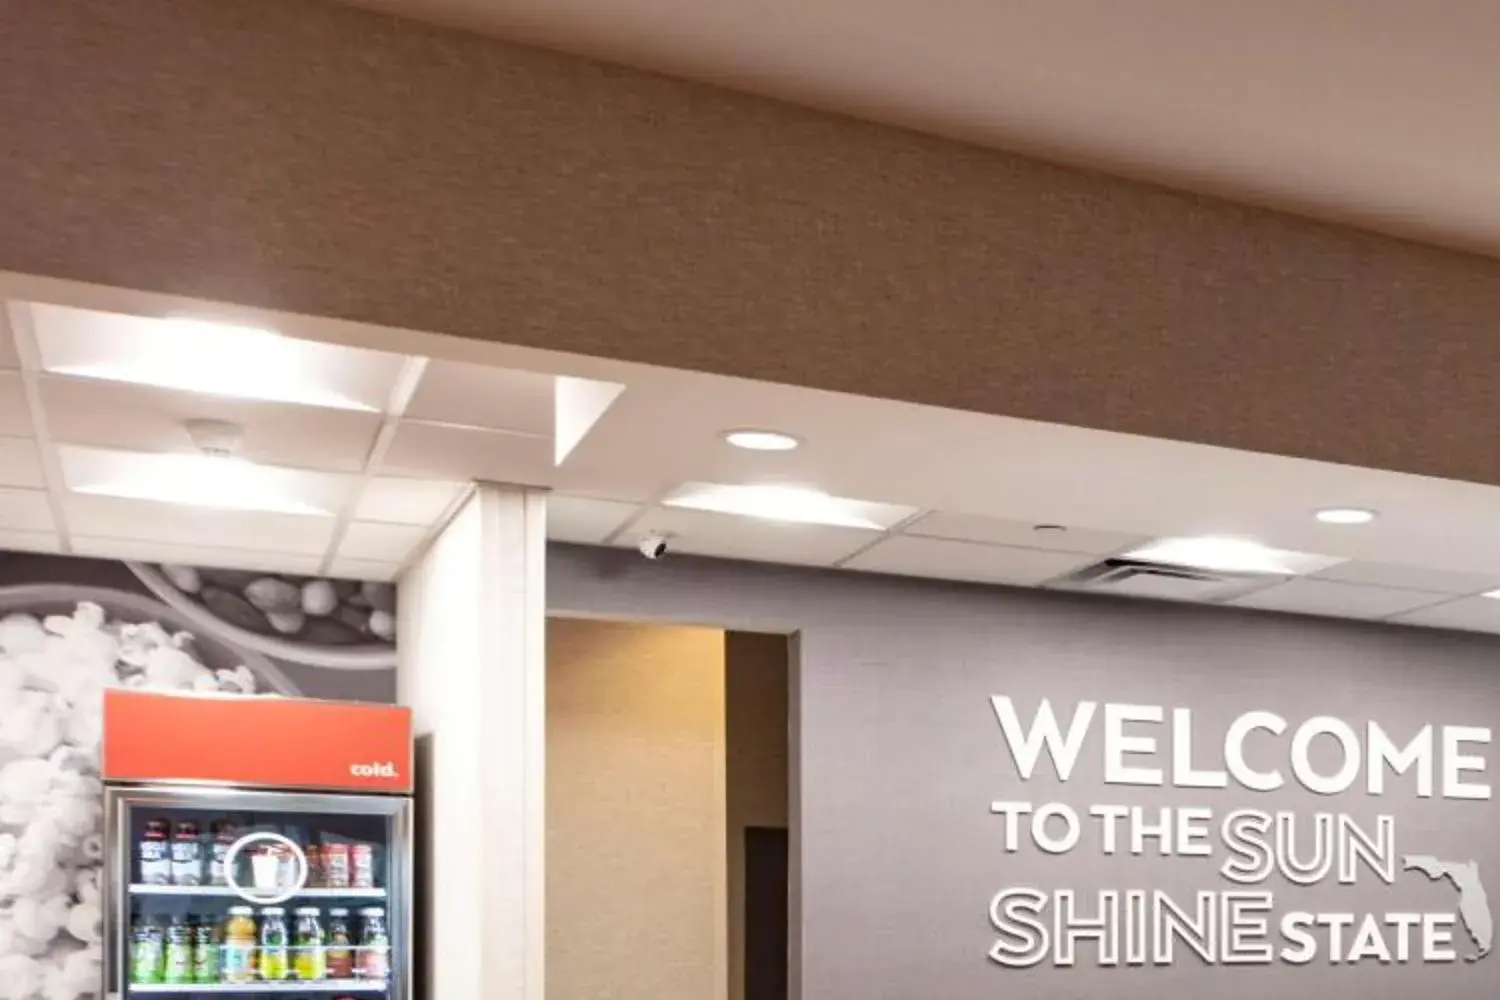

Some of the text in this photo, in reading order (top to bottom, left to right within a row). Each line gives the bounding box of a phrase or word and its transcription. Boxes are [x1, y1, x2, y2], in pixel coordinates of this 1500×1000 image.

[990, 694, 1493, 800] WELCOME
[991, 801, 1395, 885] TO THE SUN
[987, 886, 1457, 968] SHINE STATE
